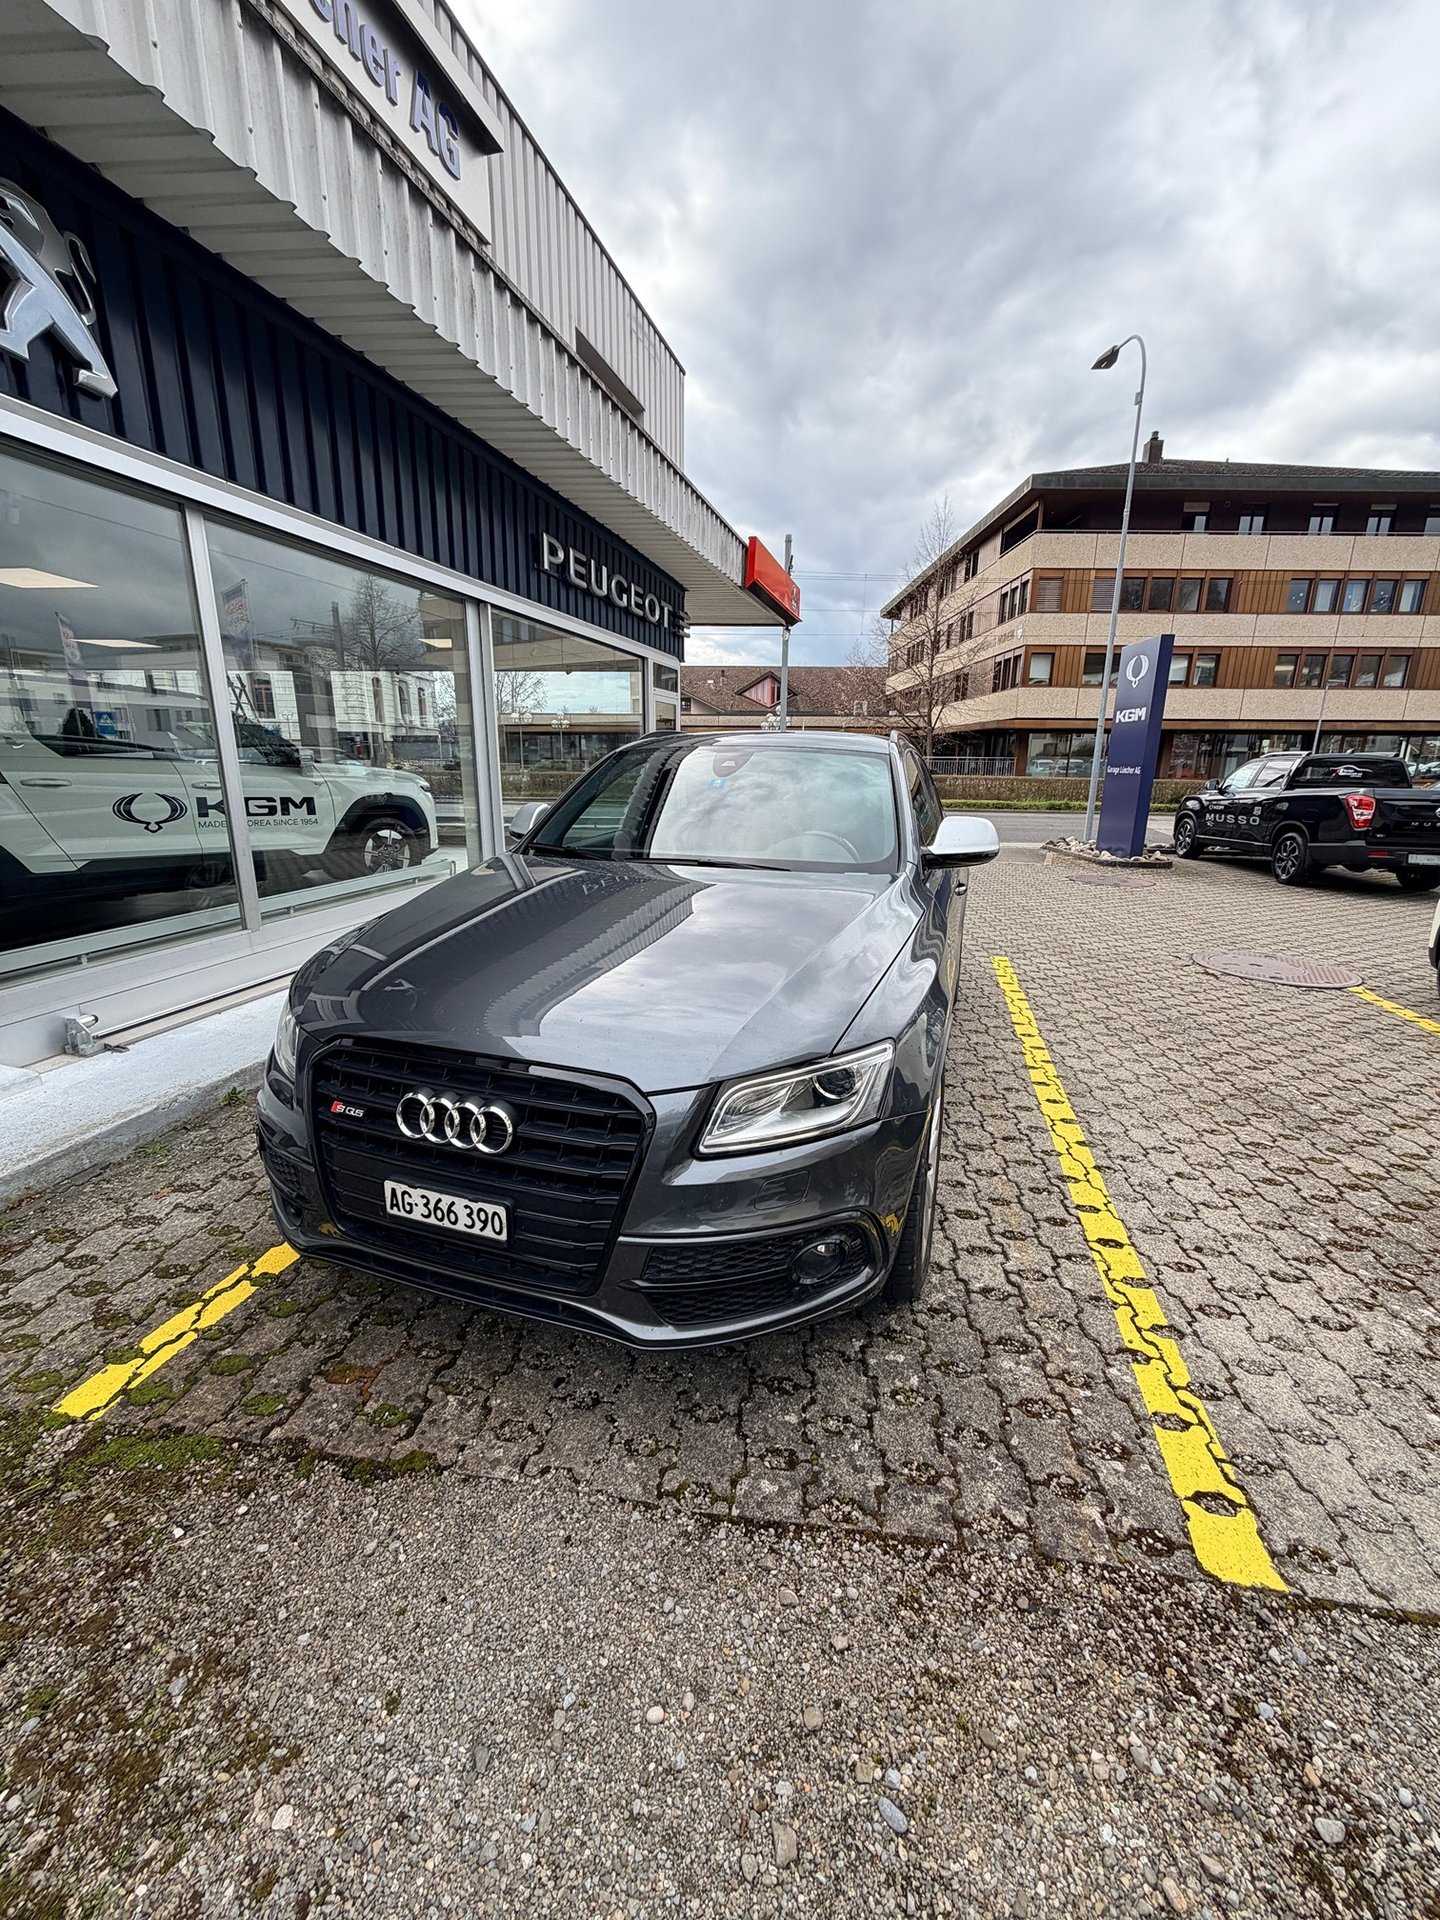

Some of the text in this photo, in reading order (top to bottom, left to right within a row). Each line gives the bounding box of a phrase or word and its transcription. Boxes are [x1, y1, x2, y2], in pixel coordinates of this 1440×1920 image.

[409, 69, 461, 181] AG
[542, 531, 674, 629] PEUGEOT
[1115, 707, 1147, 723] KGM
[195, 796, 317, 818] KGM
[198, 818, 319, 829] MADE OREA SINCE 1954
[1205, 813, 1260, 825] MUSSO
